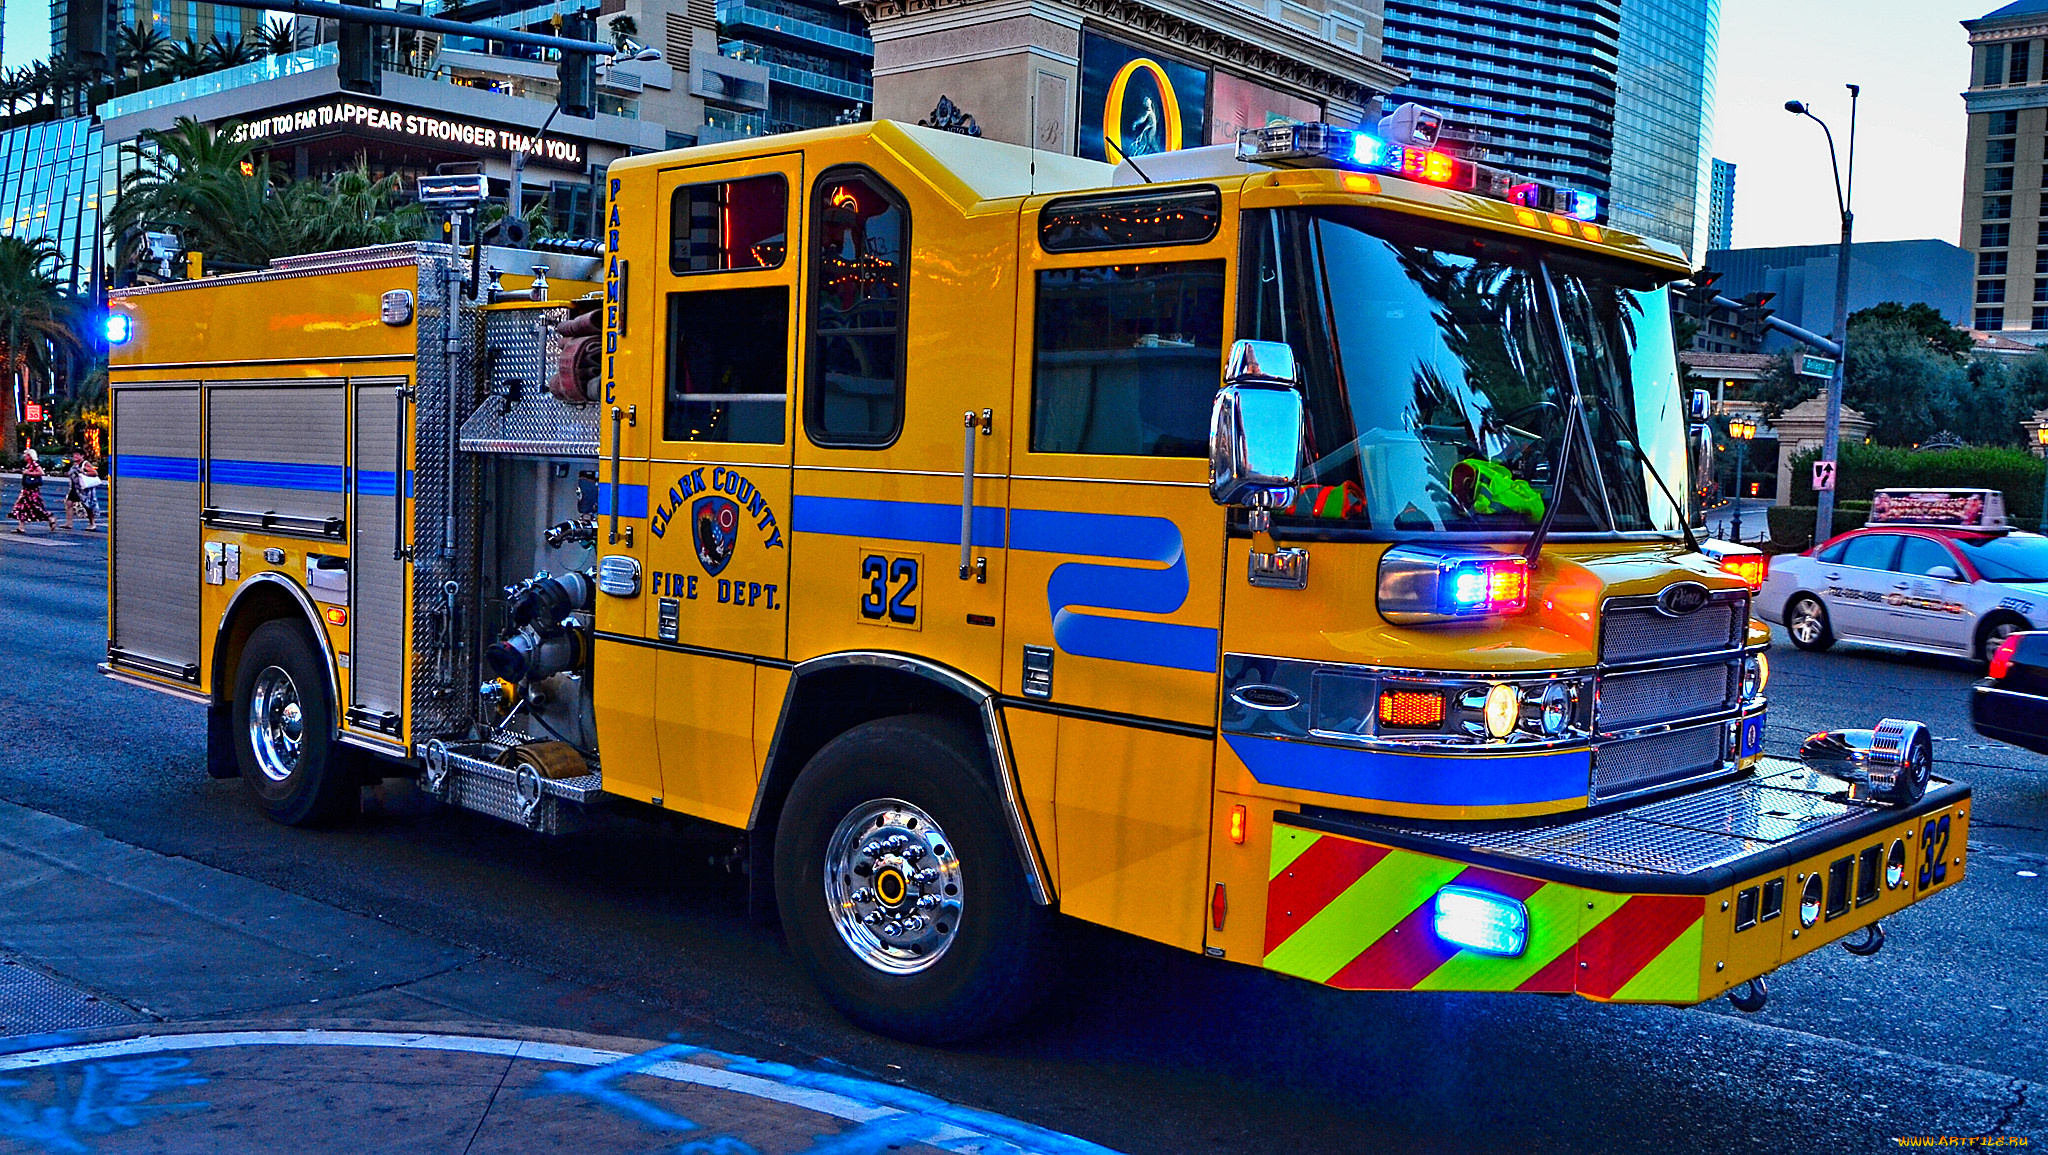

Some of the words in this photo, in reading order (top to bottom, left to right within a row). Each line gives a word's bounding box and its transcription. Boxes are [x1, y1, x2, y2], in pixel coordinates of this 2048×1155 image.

[250, 118, 271, 139] OUT
[273, 114, 294, 135] TOO
[295, 108, 317, 130] FAR
[318, 105, 333, 125] TO
[334, 103, 402, 132] APPEAR
[406, 115, 496, 148] STRONGER
[499, 131, 543, 156] THAN
[545, 140, 581, 162] YOU.
[605, 178, 621, 405] PARAMEDIC
[651, 467, 707, 539] CLARK
[713, 466, 784, 550] COUNTY
[652, 571, 698, 599] FIRE
[718, 578, 780, 610] DEPT.
[861, 554, 918, 624] 32
[1918, 813, 1951, 891] 32
